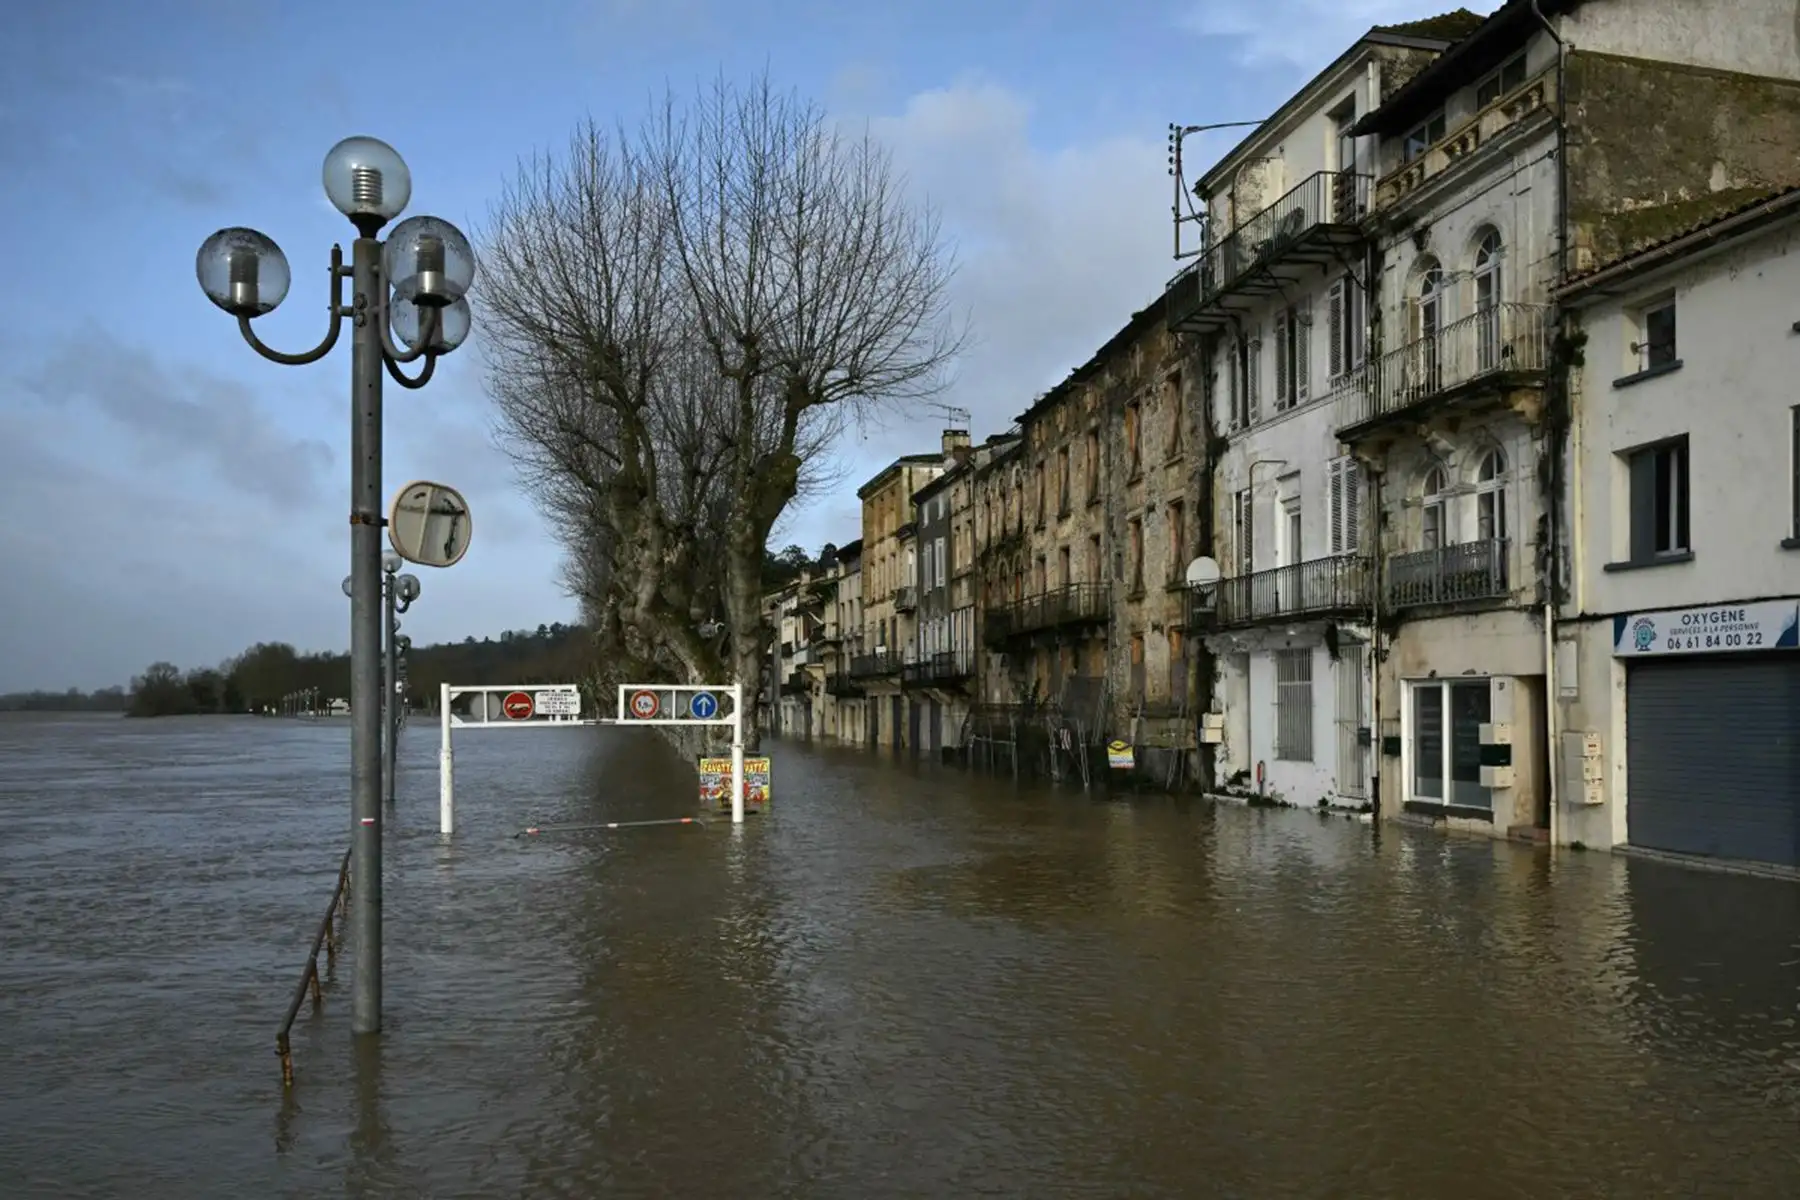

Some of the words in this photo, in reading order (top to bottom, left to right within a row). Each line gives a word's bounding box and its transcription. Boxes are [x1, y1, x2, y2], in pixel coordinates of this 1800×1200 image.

[1669, 626, 1701, 636] SERVICES
[1720, 622, 1760, 633] PERSONNE
[1667, 637, 1681, 650] 06
[1686, 636, 1699, 649] 61
[1706, 634, 1721, 648] 84
[1725, 633, 1741, 646] 00
[1746, 632, 1763, 645] 22
